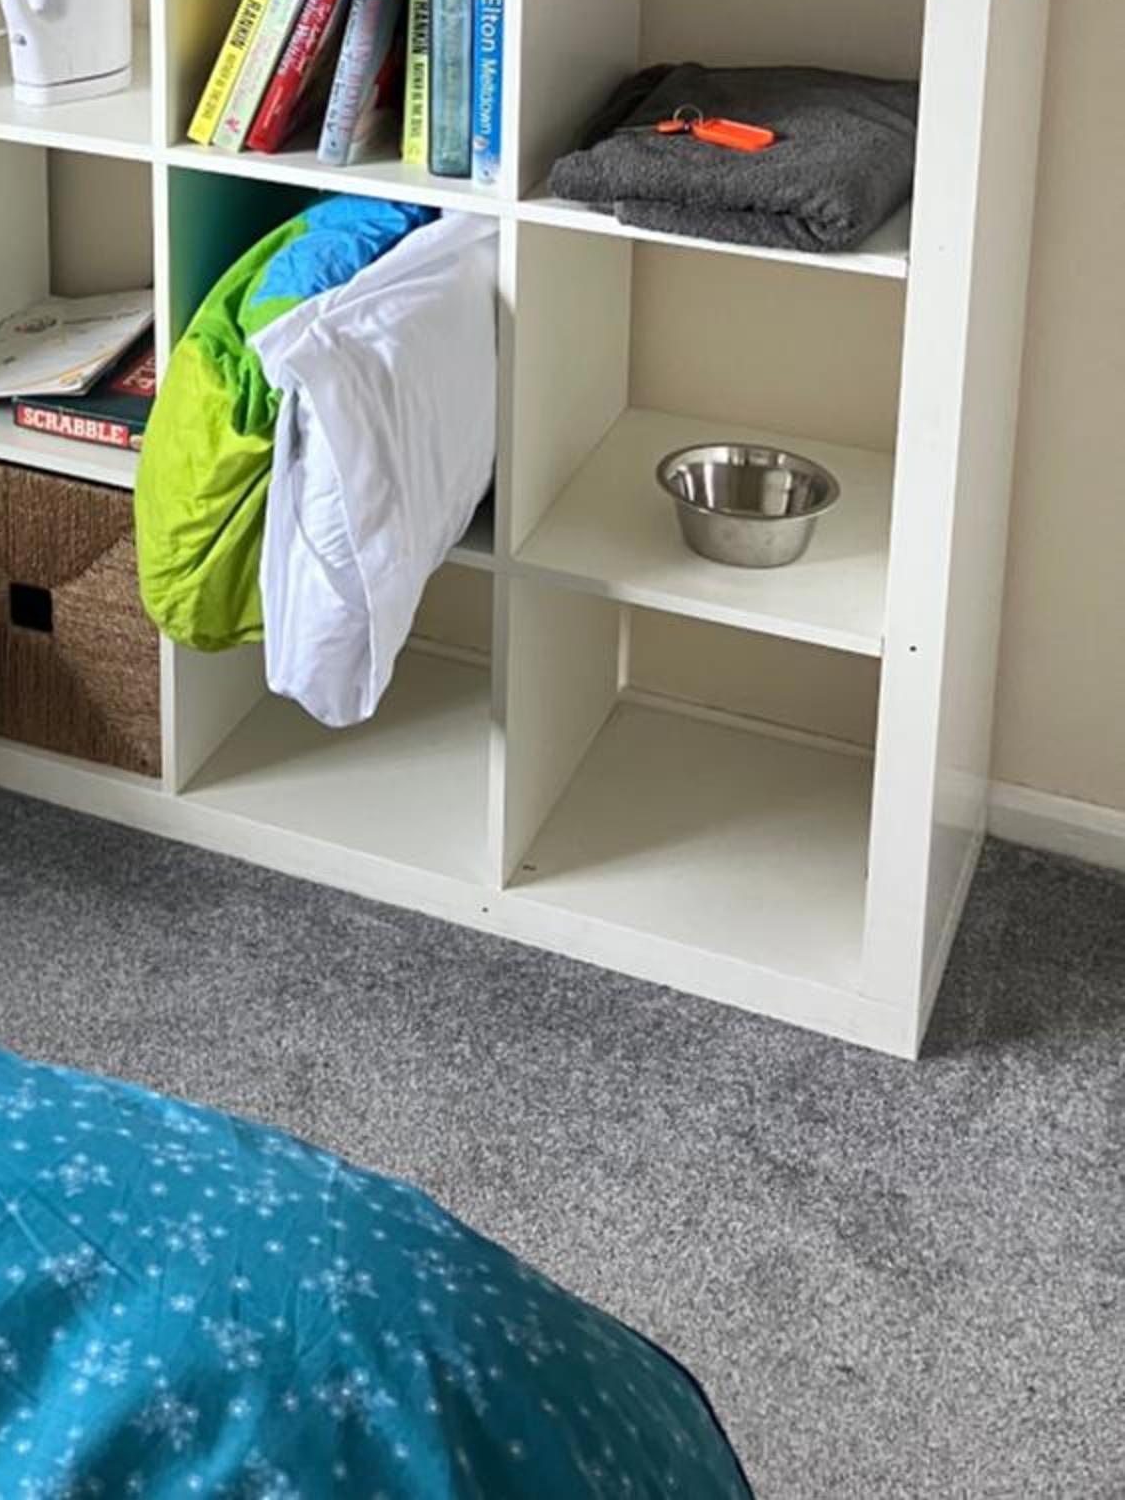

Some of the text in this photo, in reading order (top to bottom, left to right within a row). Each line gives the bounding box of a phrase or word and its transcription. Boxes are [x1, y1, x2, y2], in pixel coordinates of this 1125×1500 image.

[411, 0, 429, 56] RANKIN
[477, 57, 499, 136] Meltdown
[22, 406, 125, 446] SCRABBLE
